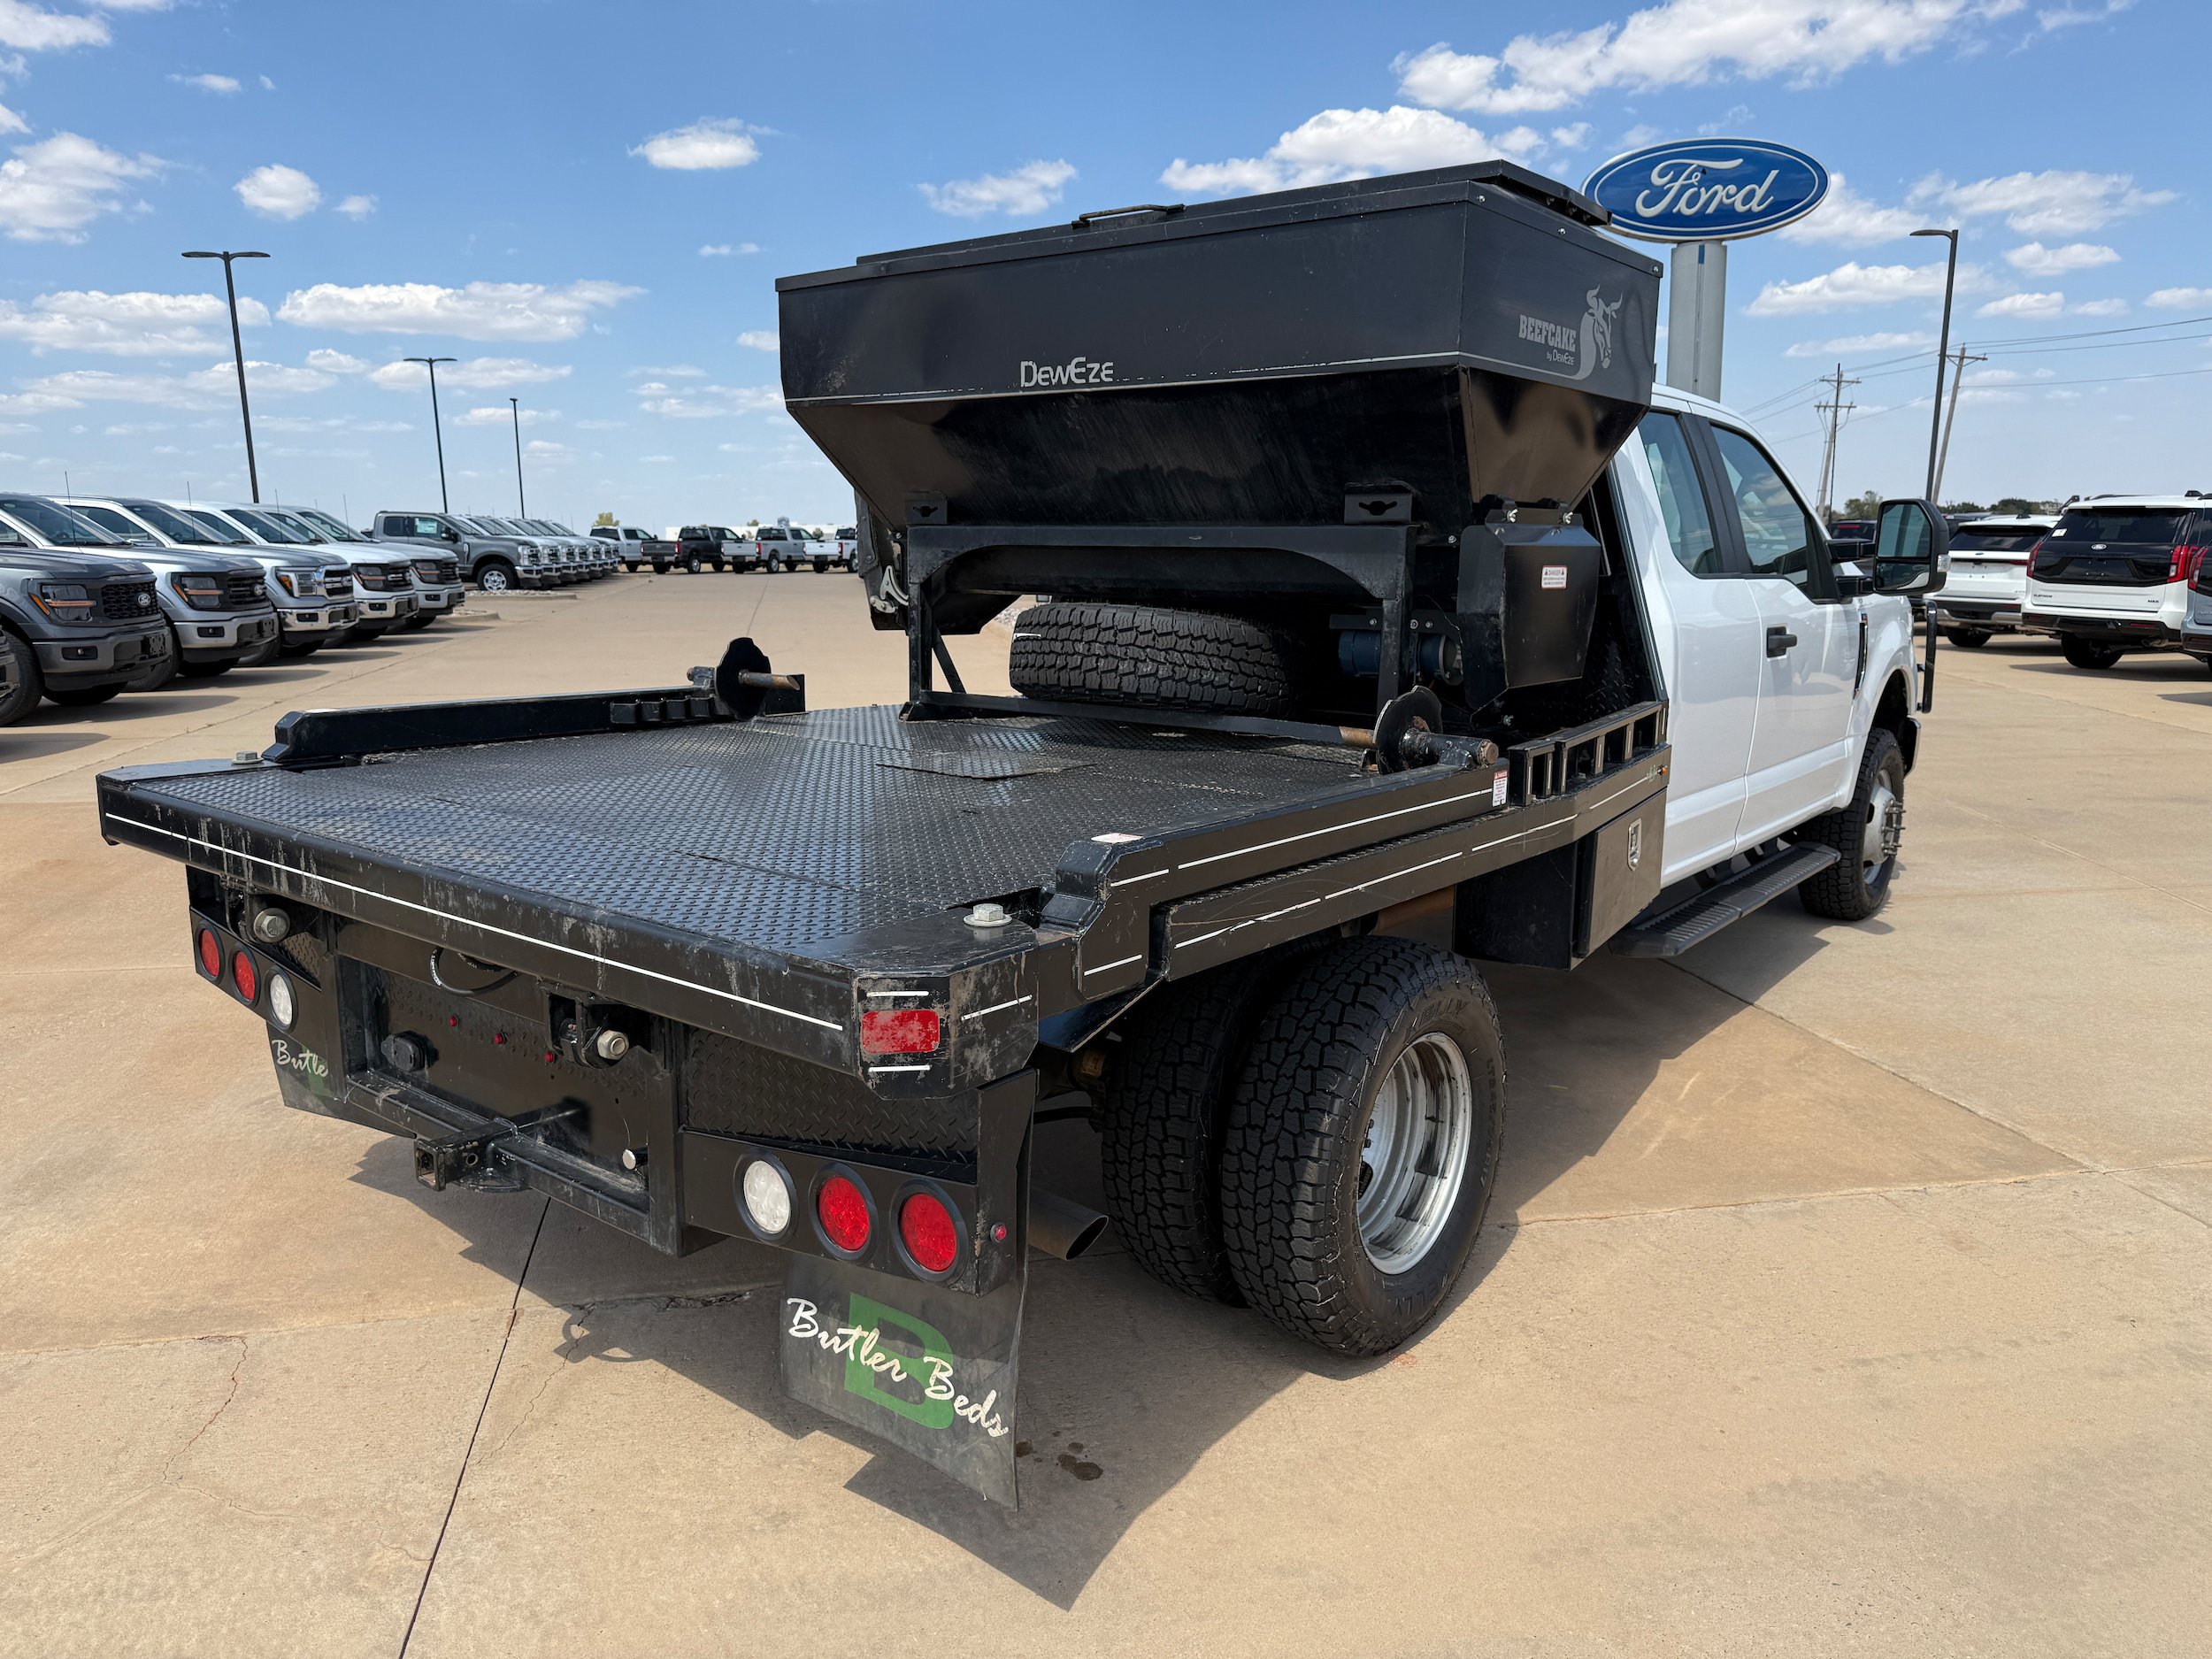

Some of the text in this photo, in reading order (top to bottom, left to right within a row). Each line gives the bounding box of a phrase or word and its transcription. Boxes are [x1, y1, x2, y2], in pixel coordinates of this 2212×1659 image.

[1635, 158, 1780, 218] Ford
[1518, 314, 1576, 352] BEEFCAKE
[272, 1039, 329, 1078] Butle
[787, 1297, 1010, 1438] Butler Beds
